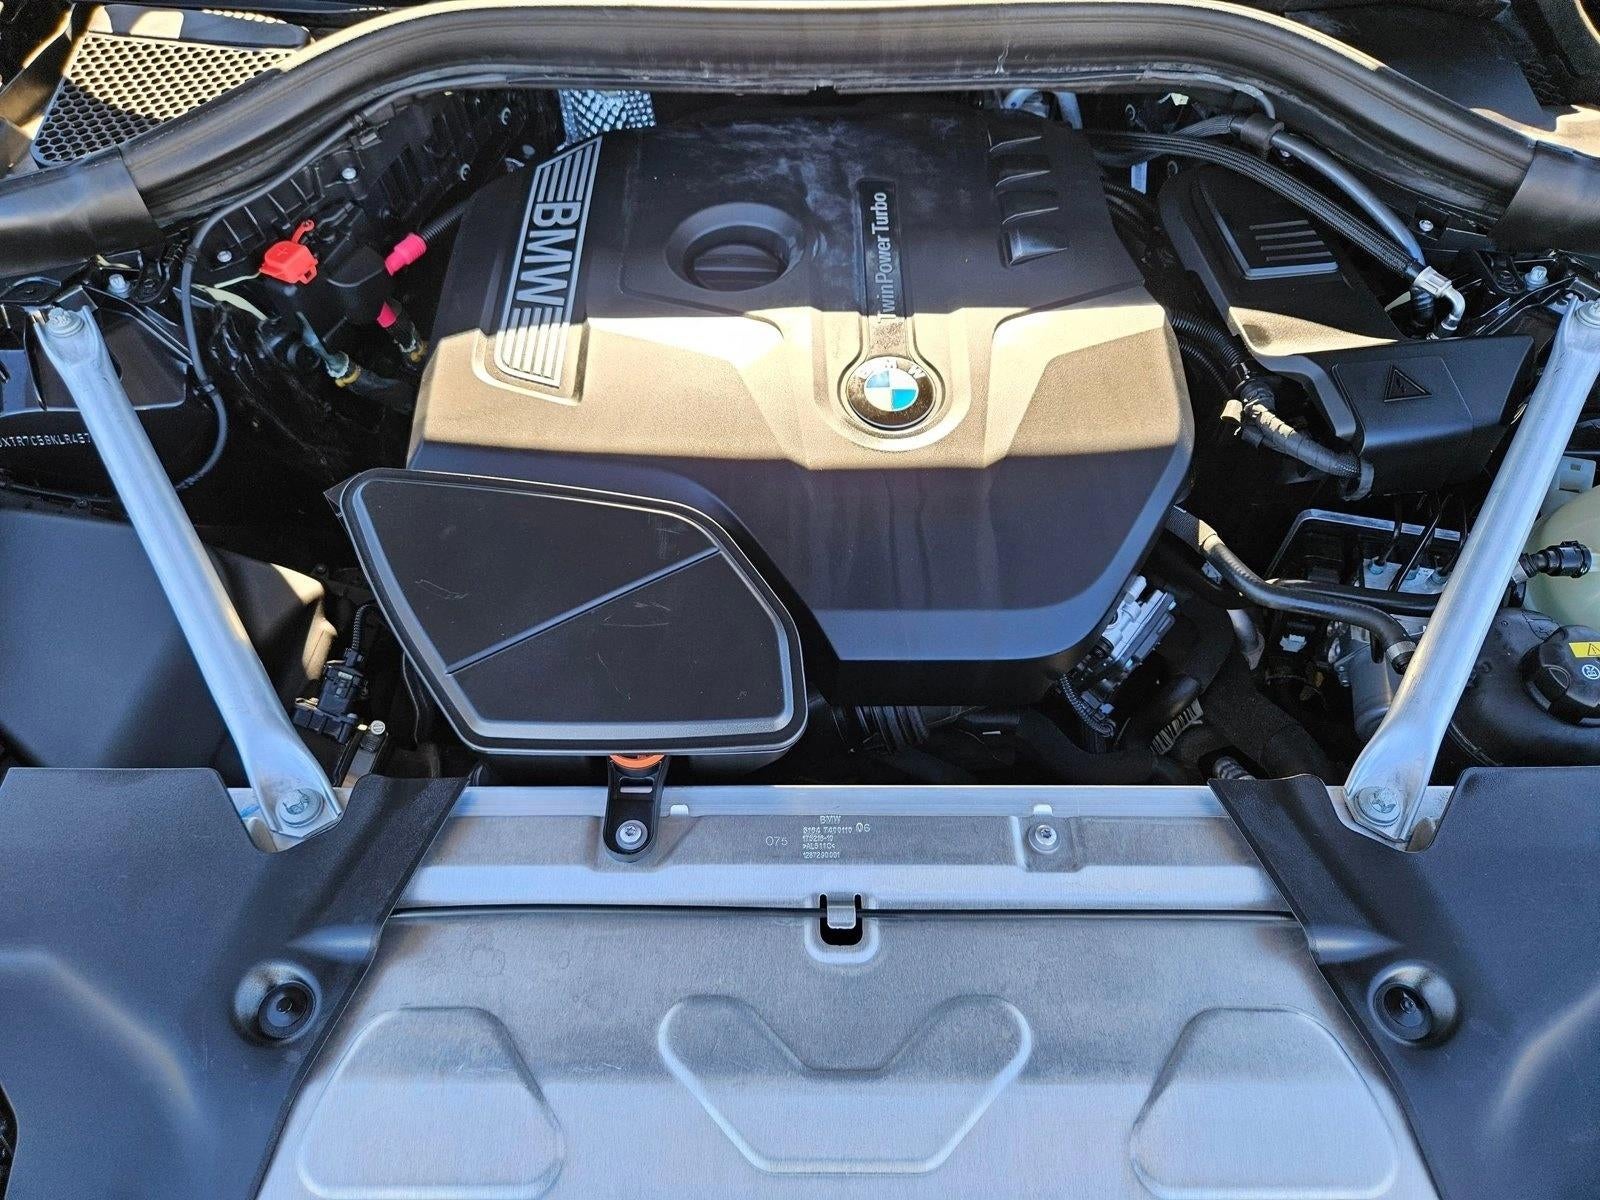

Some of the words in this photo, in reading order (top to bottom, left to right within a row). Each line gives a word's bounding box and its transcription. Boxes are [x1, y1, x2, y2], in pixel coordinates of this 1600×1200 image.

[870, 191, 890, 235] Turbo
[516, 201, 582, 306] BMW
[874, 234, 897, 323] TwinPower
[0, 432, 92, 448] XTR7C58KLR457
[820, 815, 841, 824] BMW
[765, 836, 788, 847] 075
